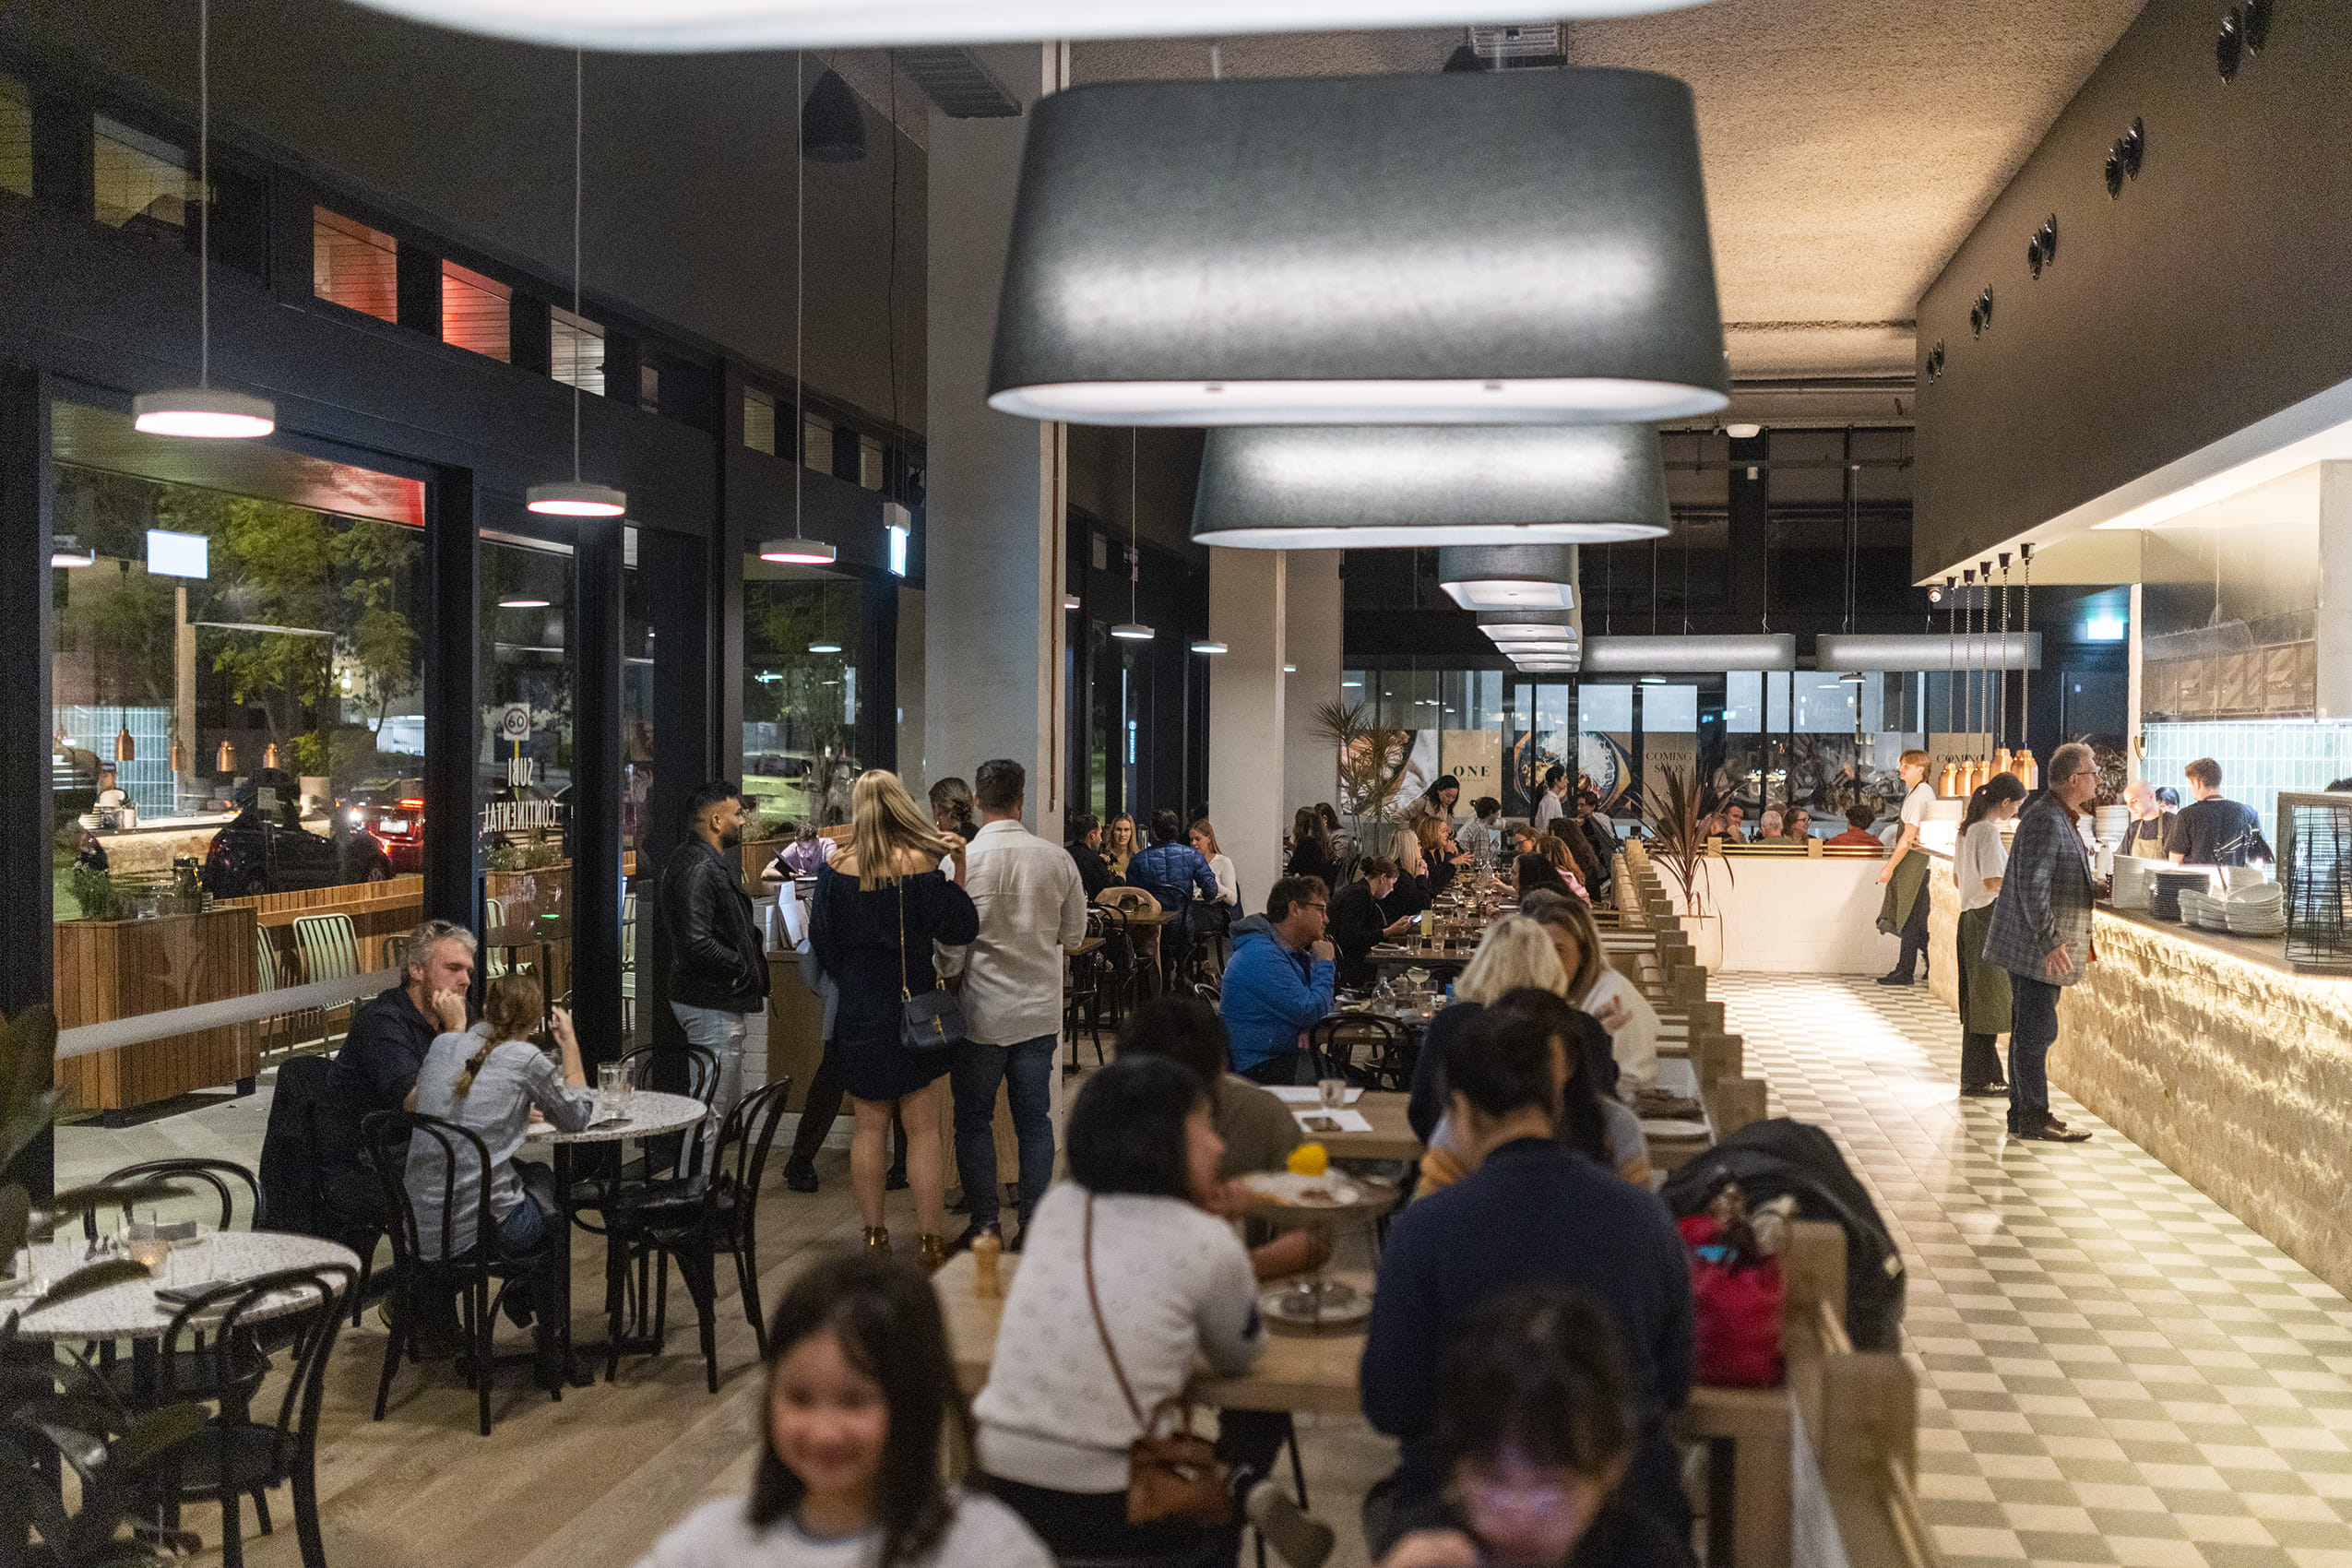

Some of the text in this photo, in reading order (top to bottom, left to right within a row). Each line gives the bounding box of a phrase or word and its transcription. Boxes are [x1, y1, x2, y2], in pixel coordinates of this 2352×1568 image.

[508, 715, 524, 728] 60
[1645, 752, 1692, 761] COMING
[1936, 754, 1985, 762] COMNG
[1453, 766, 1491, 777] ONE
